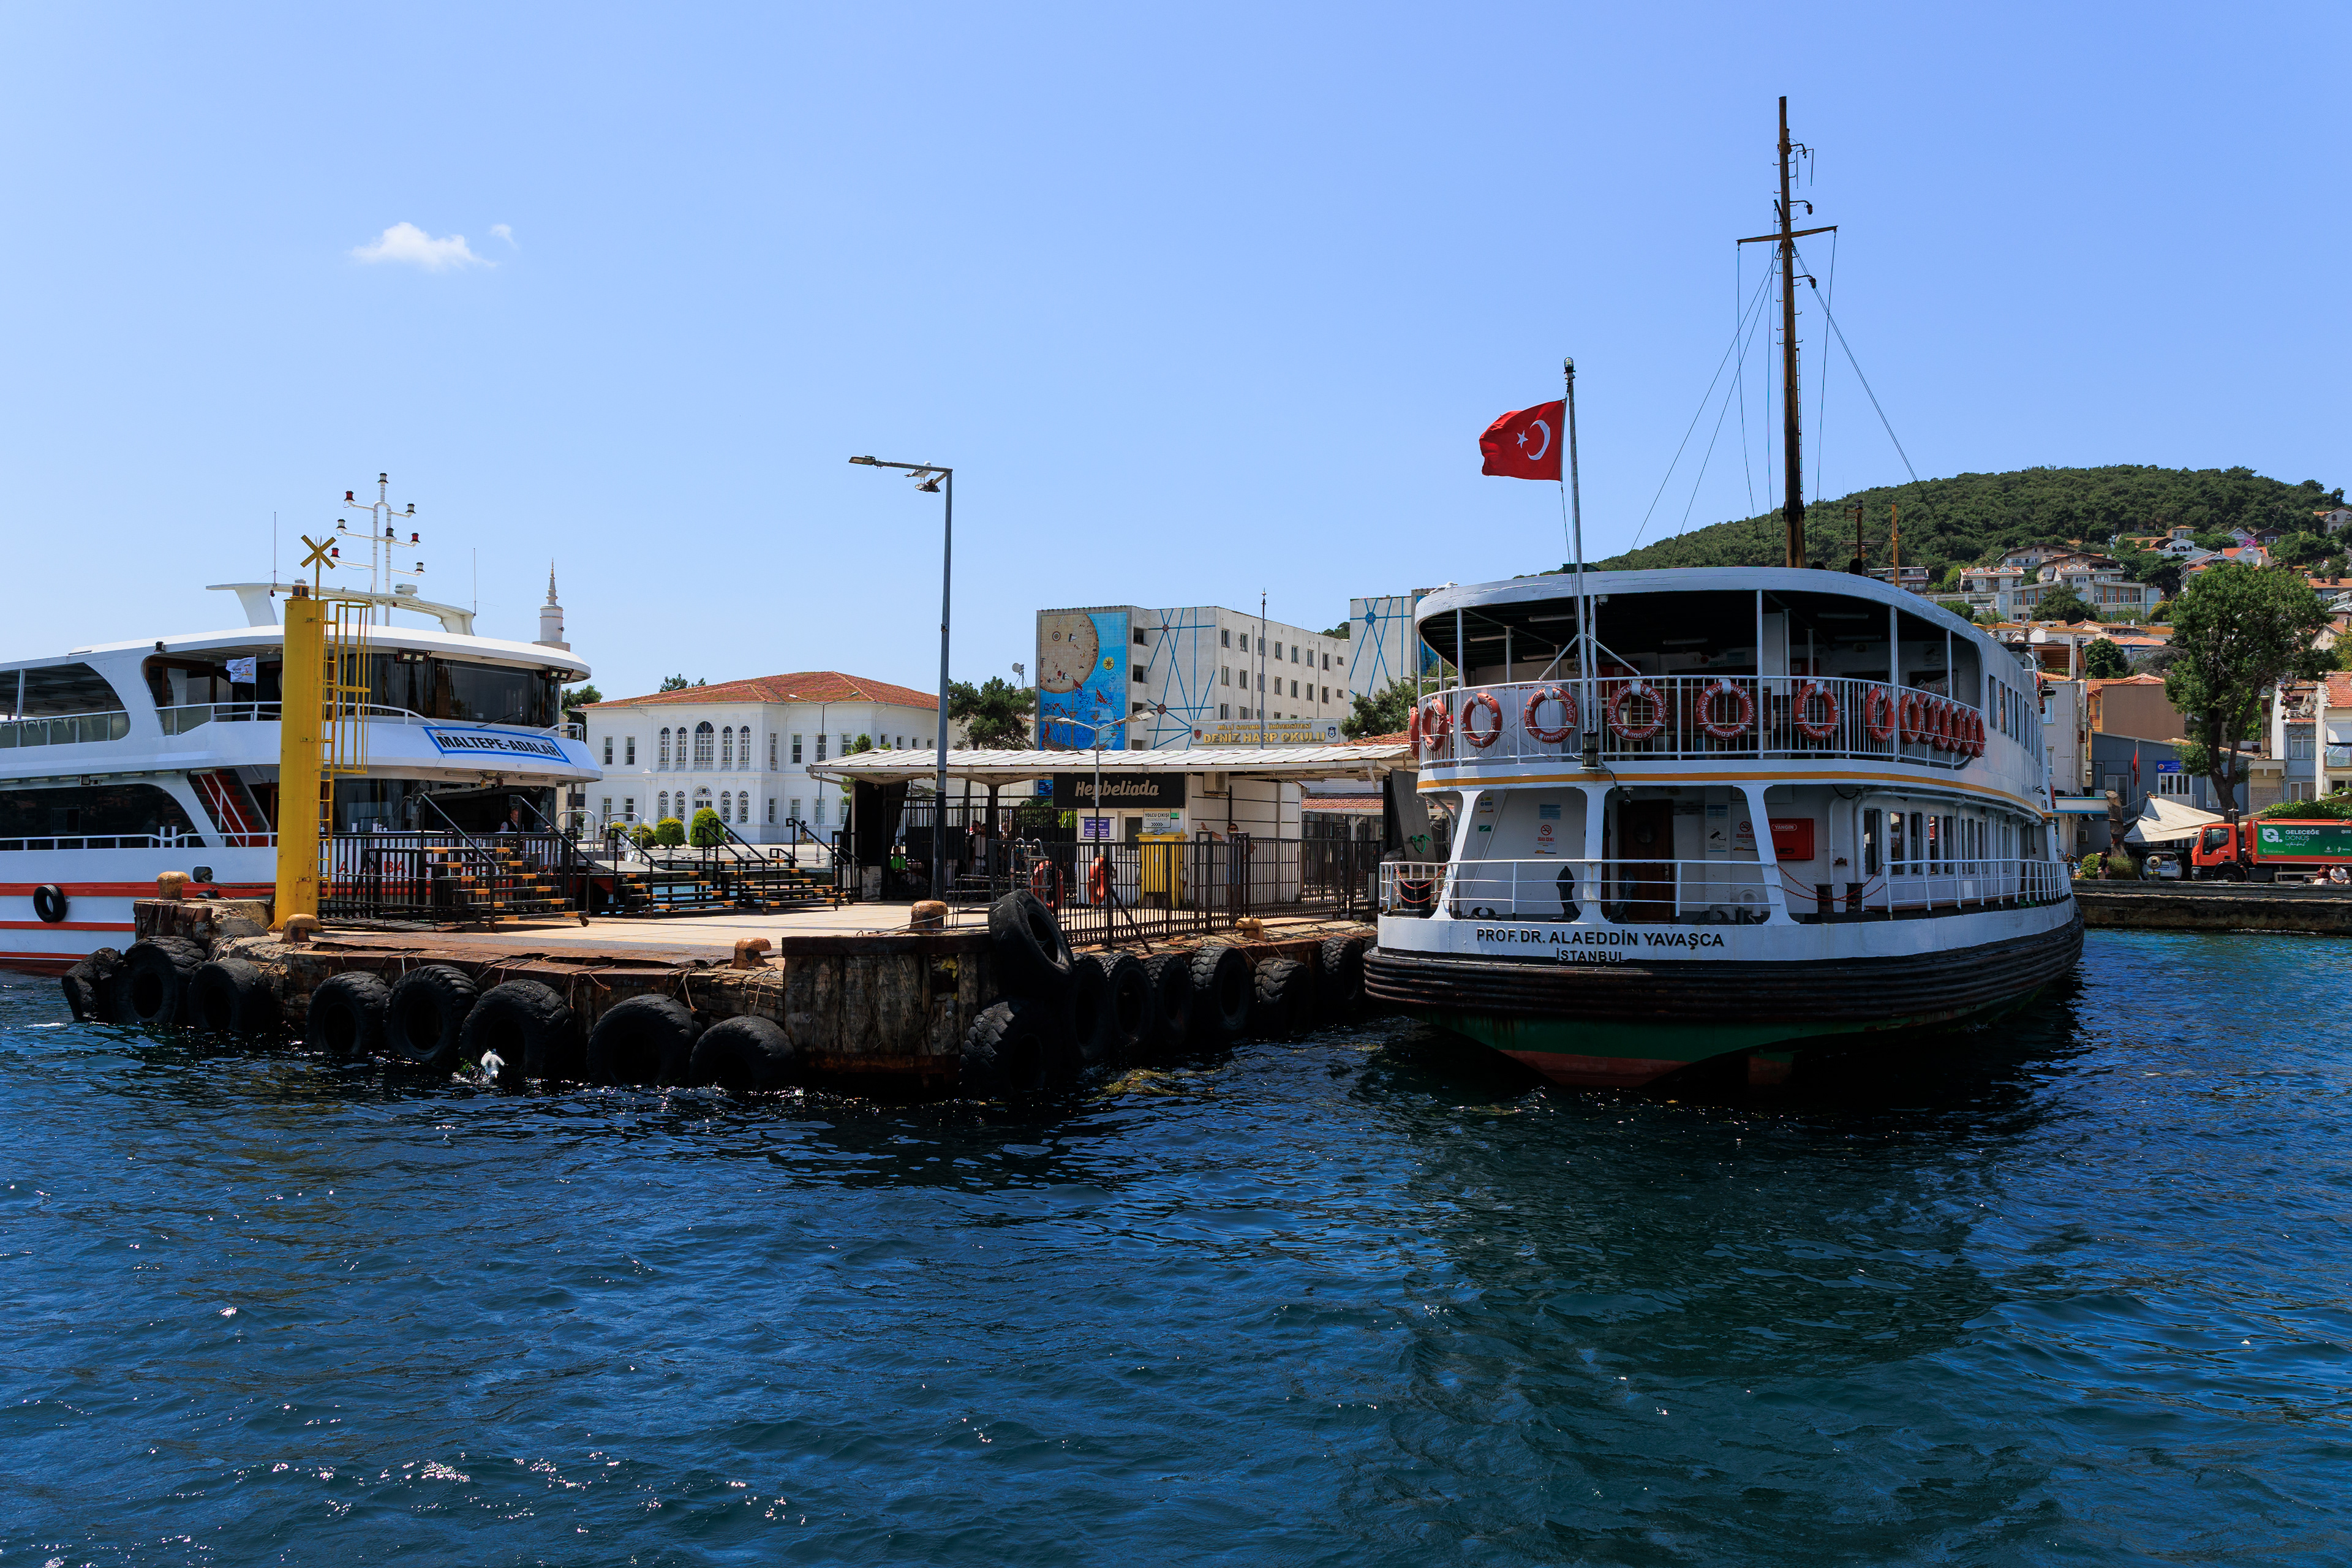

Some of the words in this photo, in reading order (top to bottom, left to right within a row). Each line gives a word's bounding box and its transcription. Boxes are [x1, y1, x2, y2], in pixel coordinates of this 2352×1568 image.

[1711, 685, 1741, 694] İSTBUL
[1203, 731, 1241, 744] DENİZ
[1243, 732, 1278, 743] HARP
[1281, 731, 1326, 742] OKULU
[1543, 729, 1568, 741] STANBUL
[436, 736, 562, 758] MALTEPE-ADALAR
[1075, 780, 1159, 800] Heybeliada
[1549, 929, 1638, 946] ALAEDDİN
[1643, 932, 1725, 951] YAVAŞCA
[1556, 947, 1626, 963] İSTANBUL
